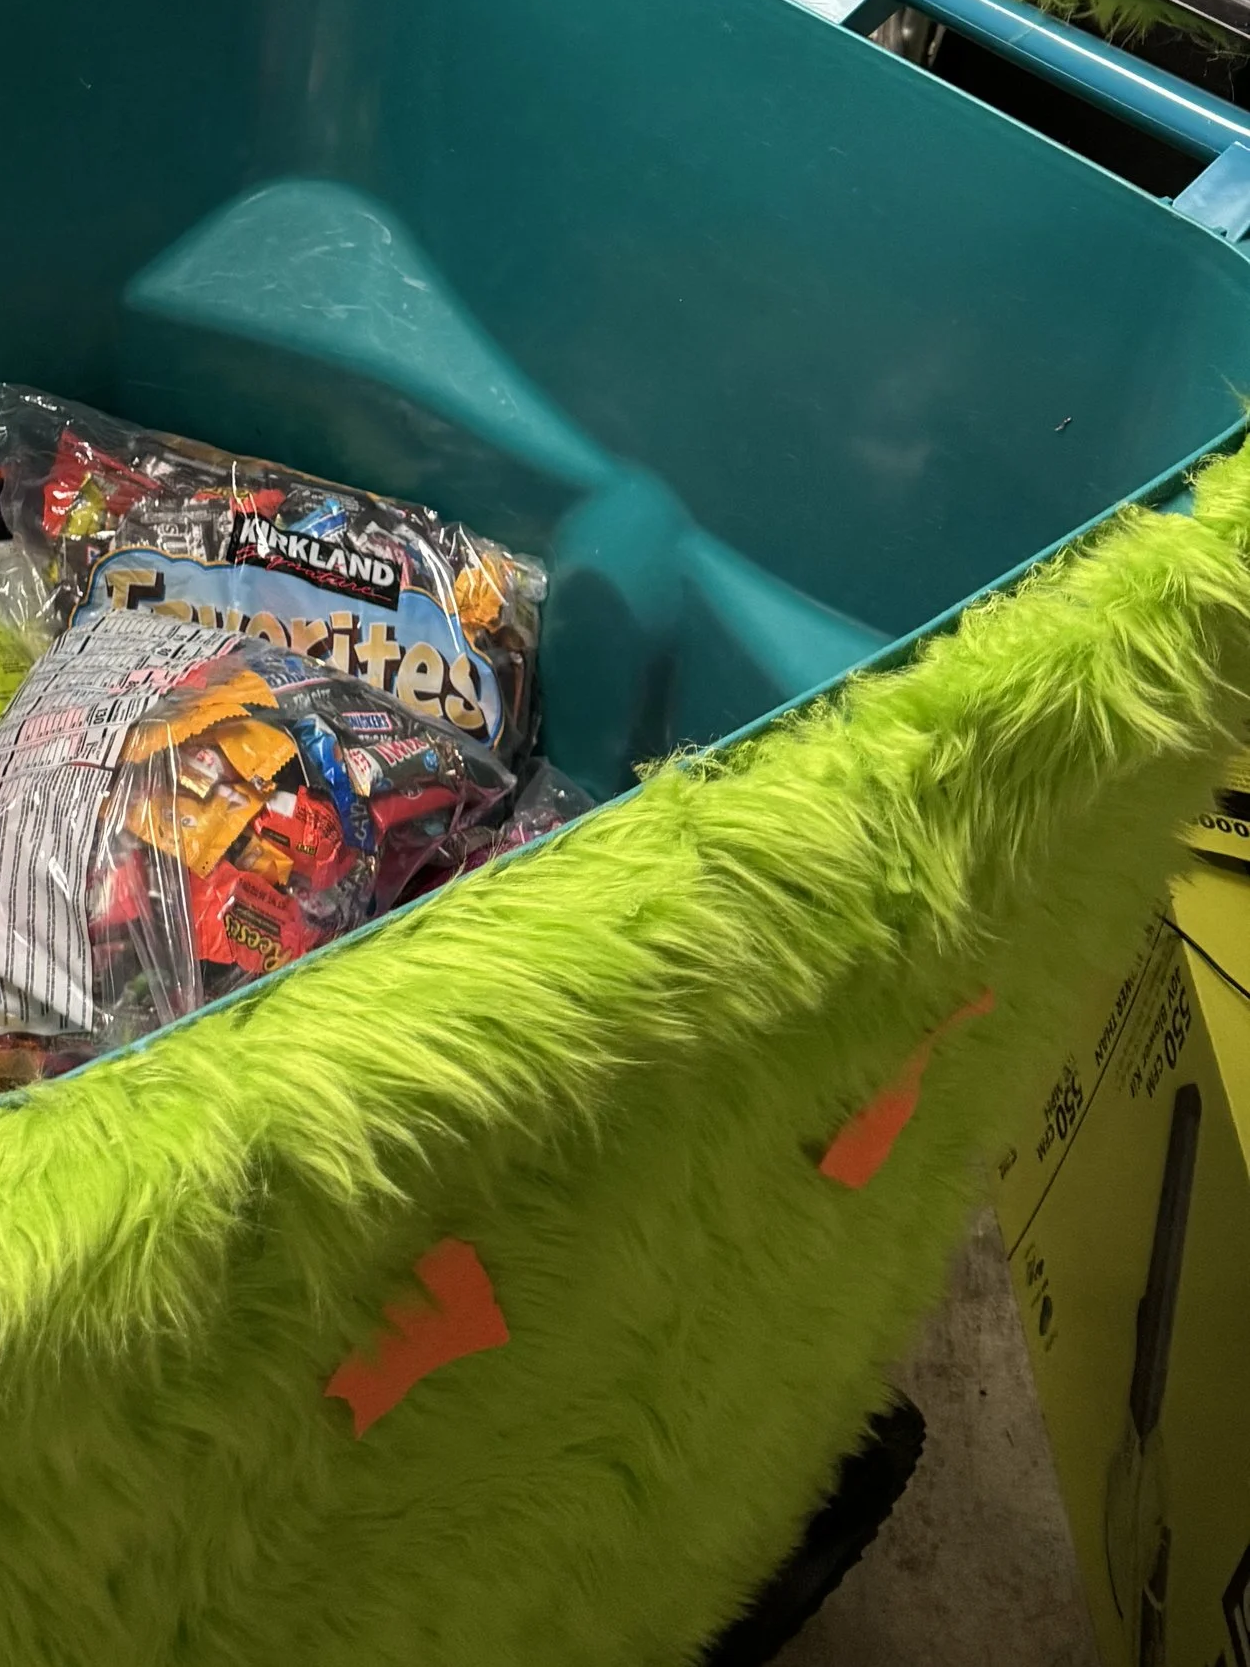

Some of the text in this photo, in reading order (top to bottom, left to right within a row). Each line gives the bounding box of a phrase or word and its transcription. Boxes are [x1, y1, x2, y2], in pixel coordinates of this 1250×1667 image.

[239, 516, 395, 588] KIRKLAND
[104, 568, 485, 731] Forites
[1094, 1011, 1119, 1068] THAN
[1164, 985, 1193, 1071] 550
[1054, 1074, 1084, 1142] 550
